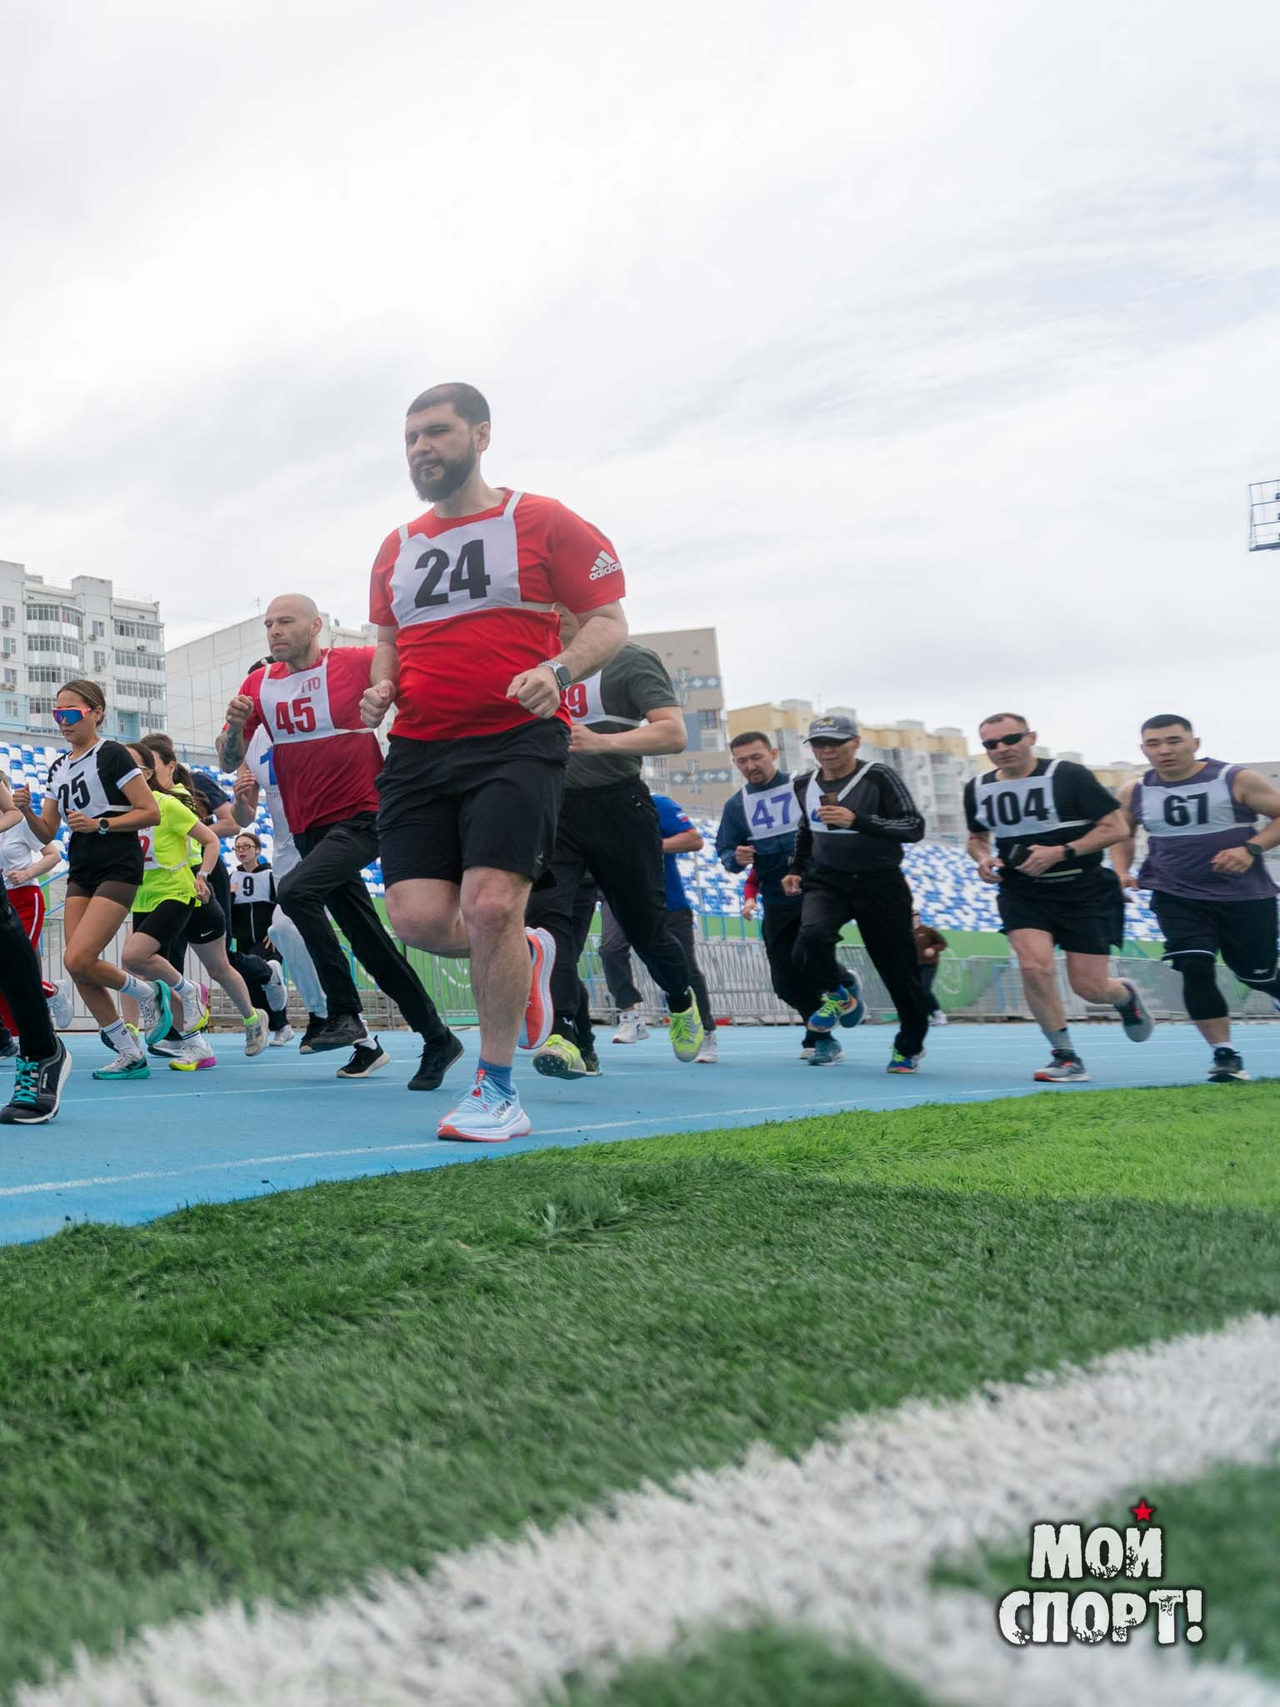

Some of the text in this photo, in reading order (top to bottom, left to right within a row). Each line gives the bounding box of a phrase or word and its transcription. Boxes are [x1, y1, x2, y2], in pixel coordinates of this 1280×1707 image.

[414, 538, 491, 608] 24
[275, 696, 317, 735] 45
[751, 792, 792, 829] 47
[981, 787, 1051, 828] 104
[1163, 791, 1210, 827] 67
[242, 875, 254, 897] 9
